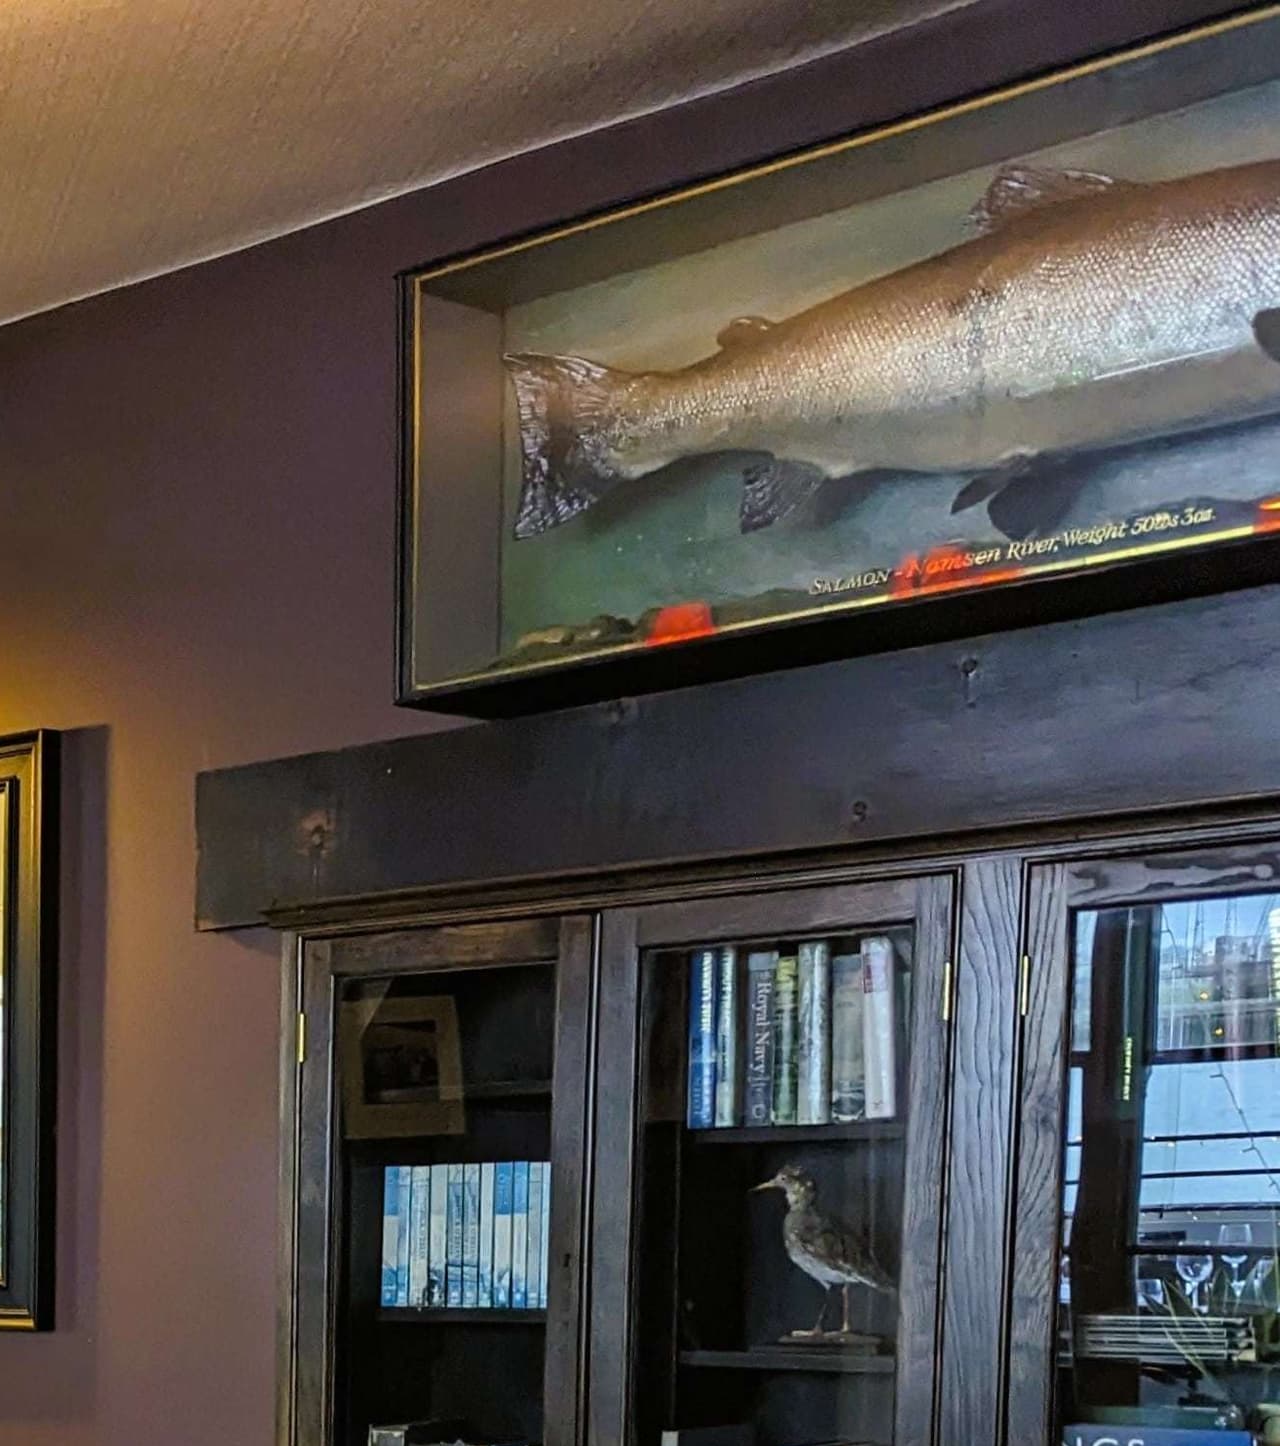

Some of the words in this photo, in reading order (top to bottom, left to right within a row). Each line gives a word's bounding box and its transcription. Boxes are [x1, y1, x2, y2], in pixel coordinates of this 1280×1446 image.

[810, 569, 891, 594] SALMON
[1063, 522, 1129, 547] Weight
[752, 982, 773, 1028] Royal
[749, 1031, 771, 1073] Navy
